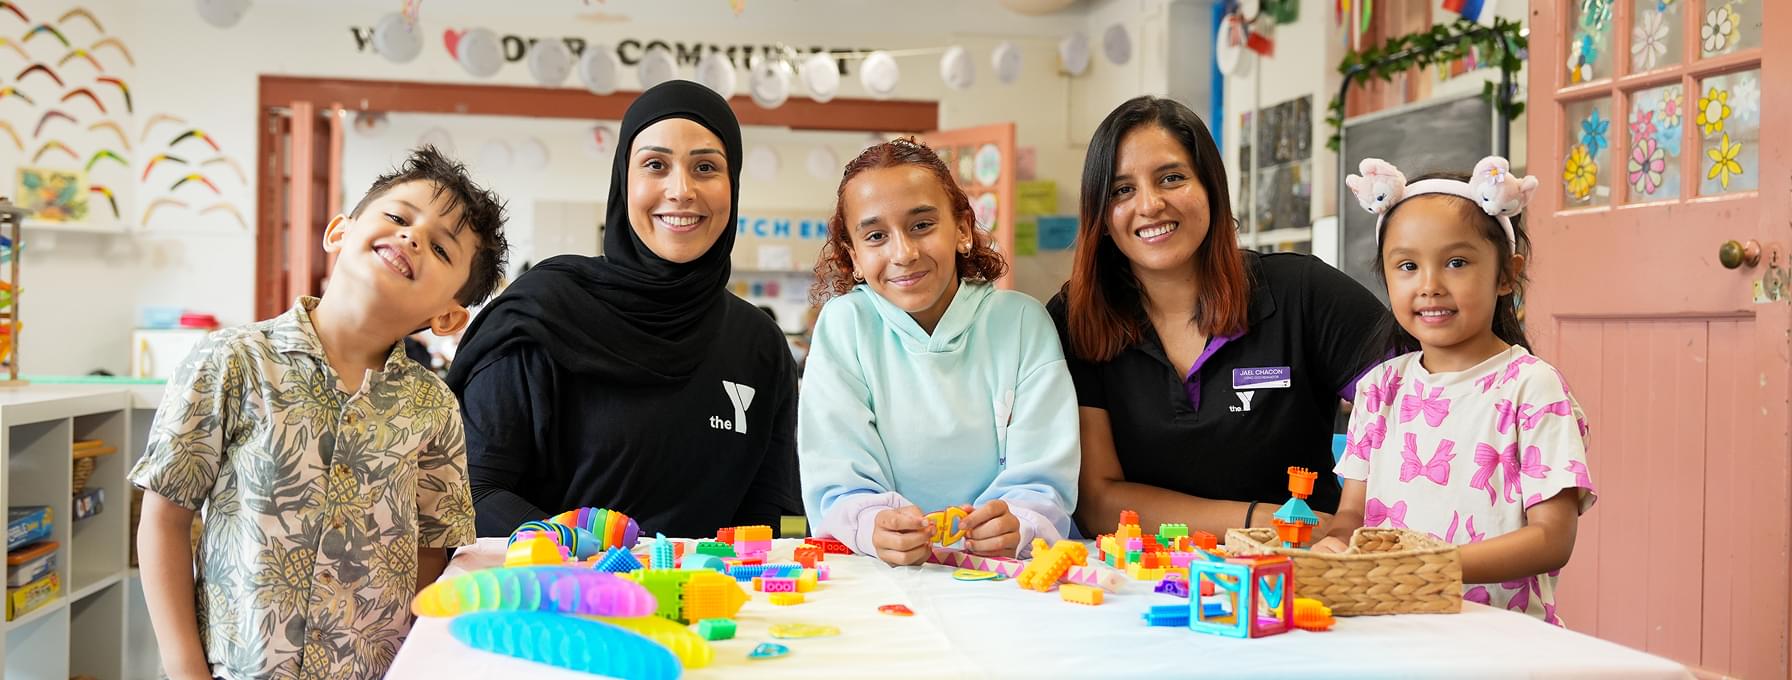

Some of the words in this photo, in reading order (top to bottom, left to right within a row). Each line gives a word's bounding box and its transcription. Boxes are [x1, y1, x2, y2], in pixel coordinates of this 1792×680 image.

[501, 35, 588, 65] OR
[709, 415, 732, 430] the
[722, 380, 756, 434] Y
[1235, 390, 1255, 411] Y
